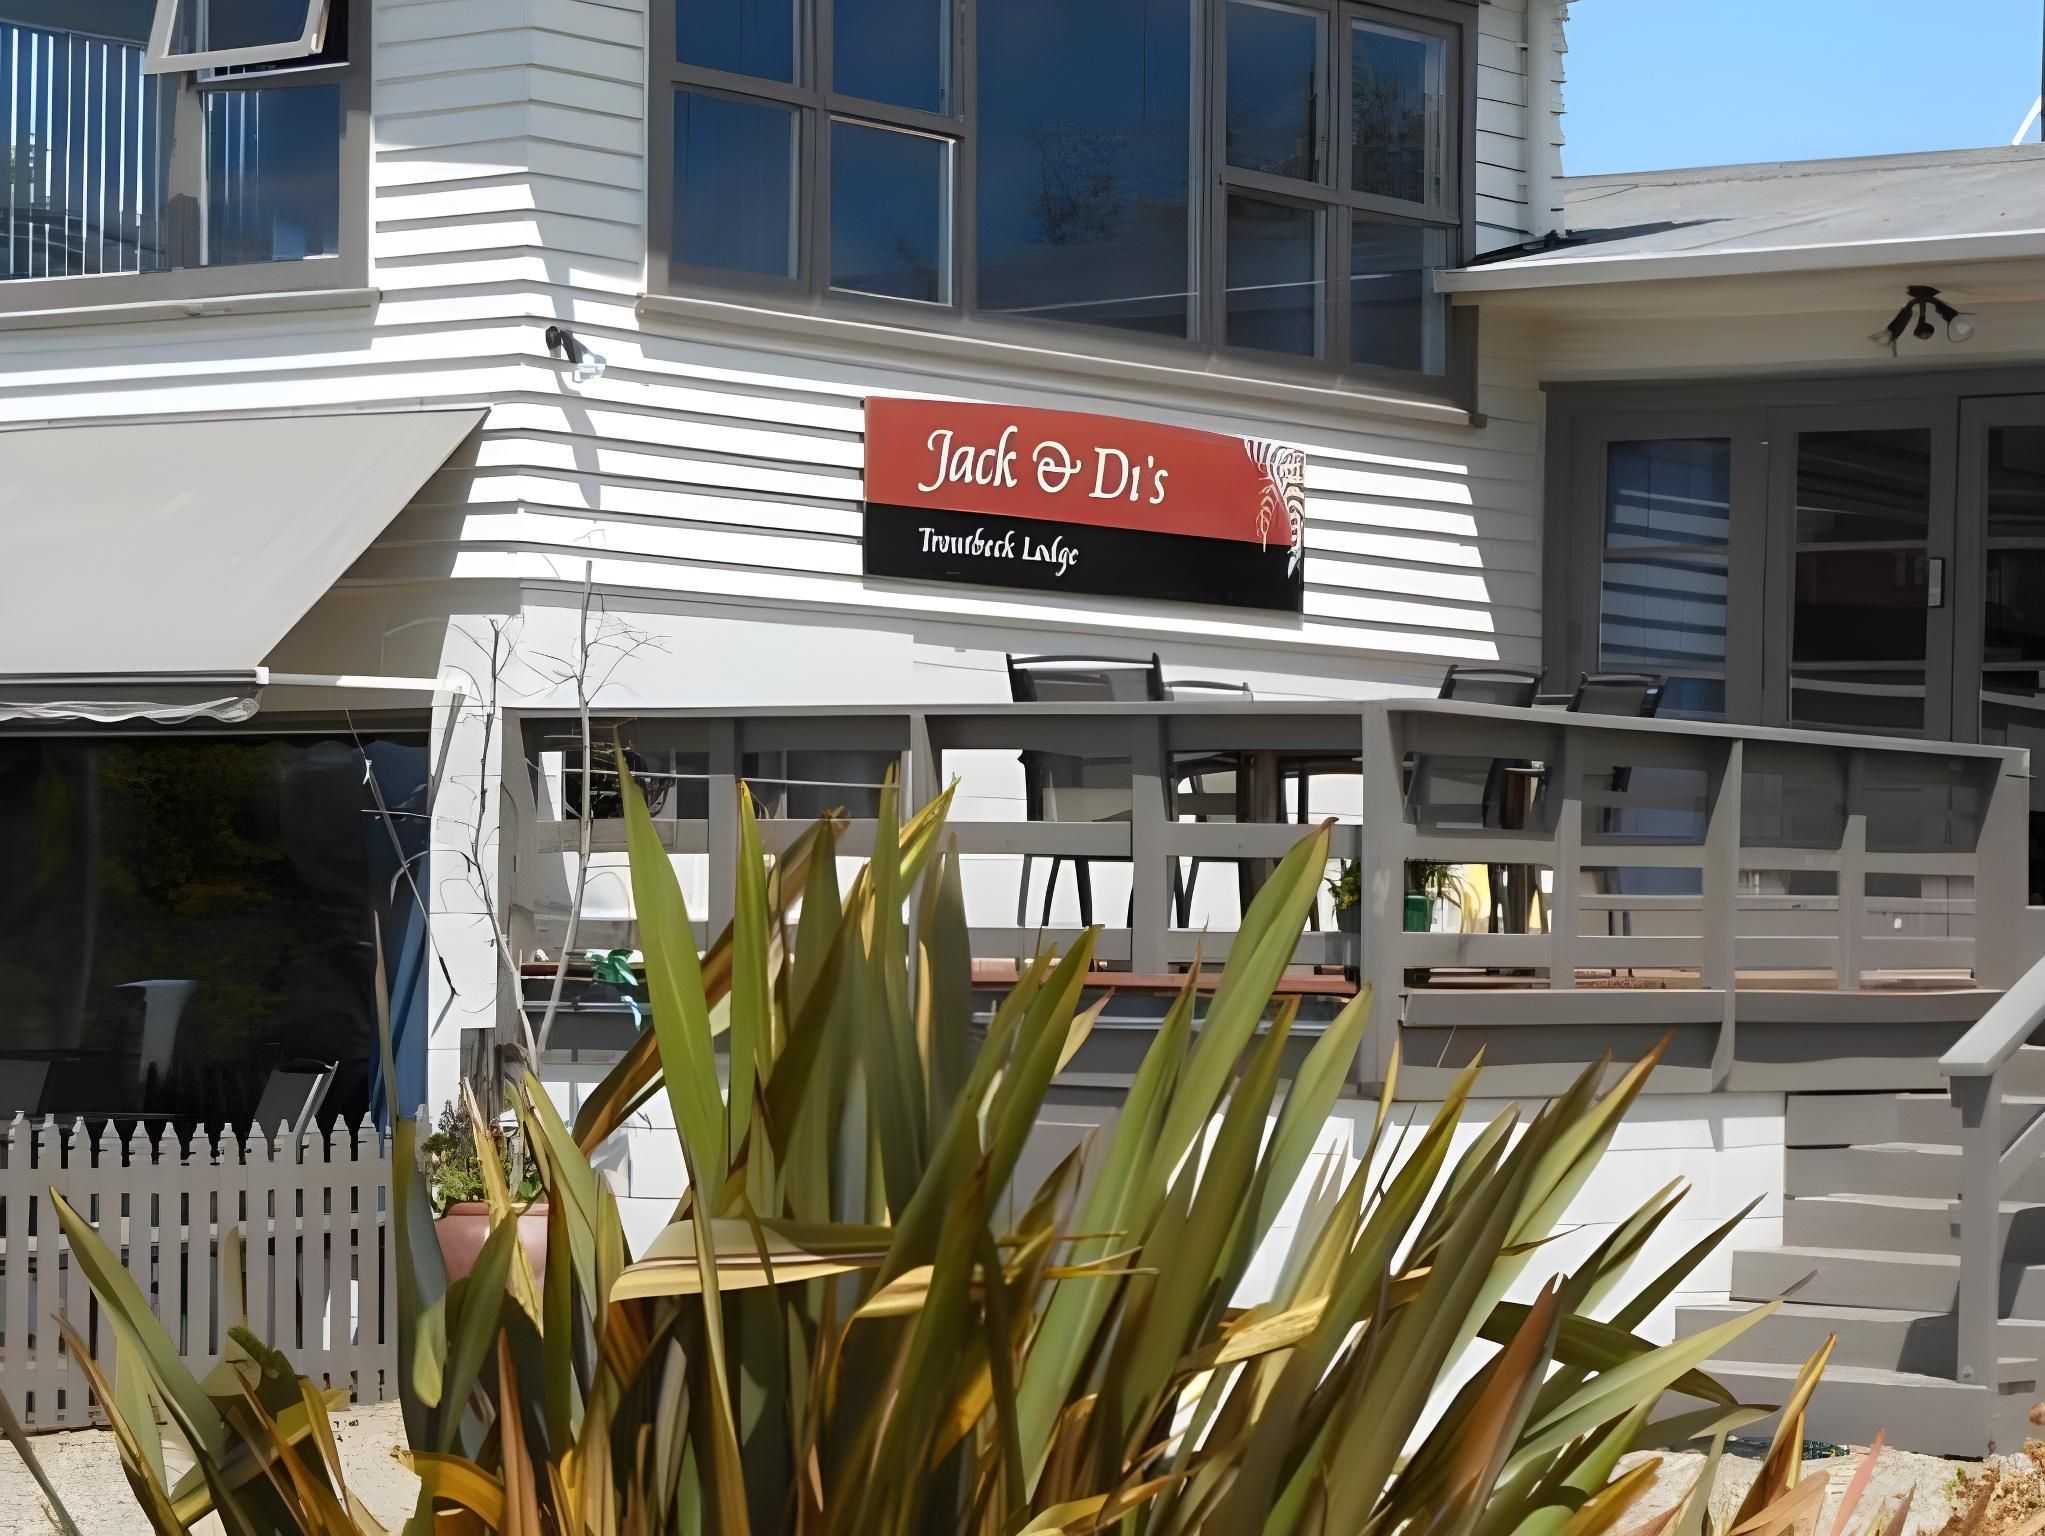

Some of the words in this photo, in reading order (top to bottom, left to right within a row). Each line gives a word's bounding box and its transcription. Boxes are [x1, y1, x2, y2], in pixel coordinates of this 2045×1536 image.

[918, 426, 1018, 491] Jack
[1033, 441, 1082, 492] &
[1089, 447, 1169, 504] Di's
